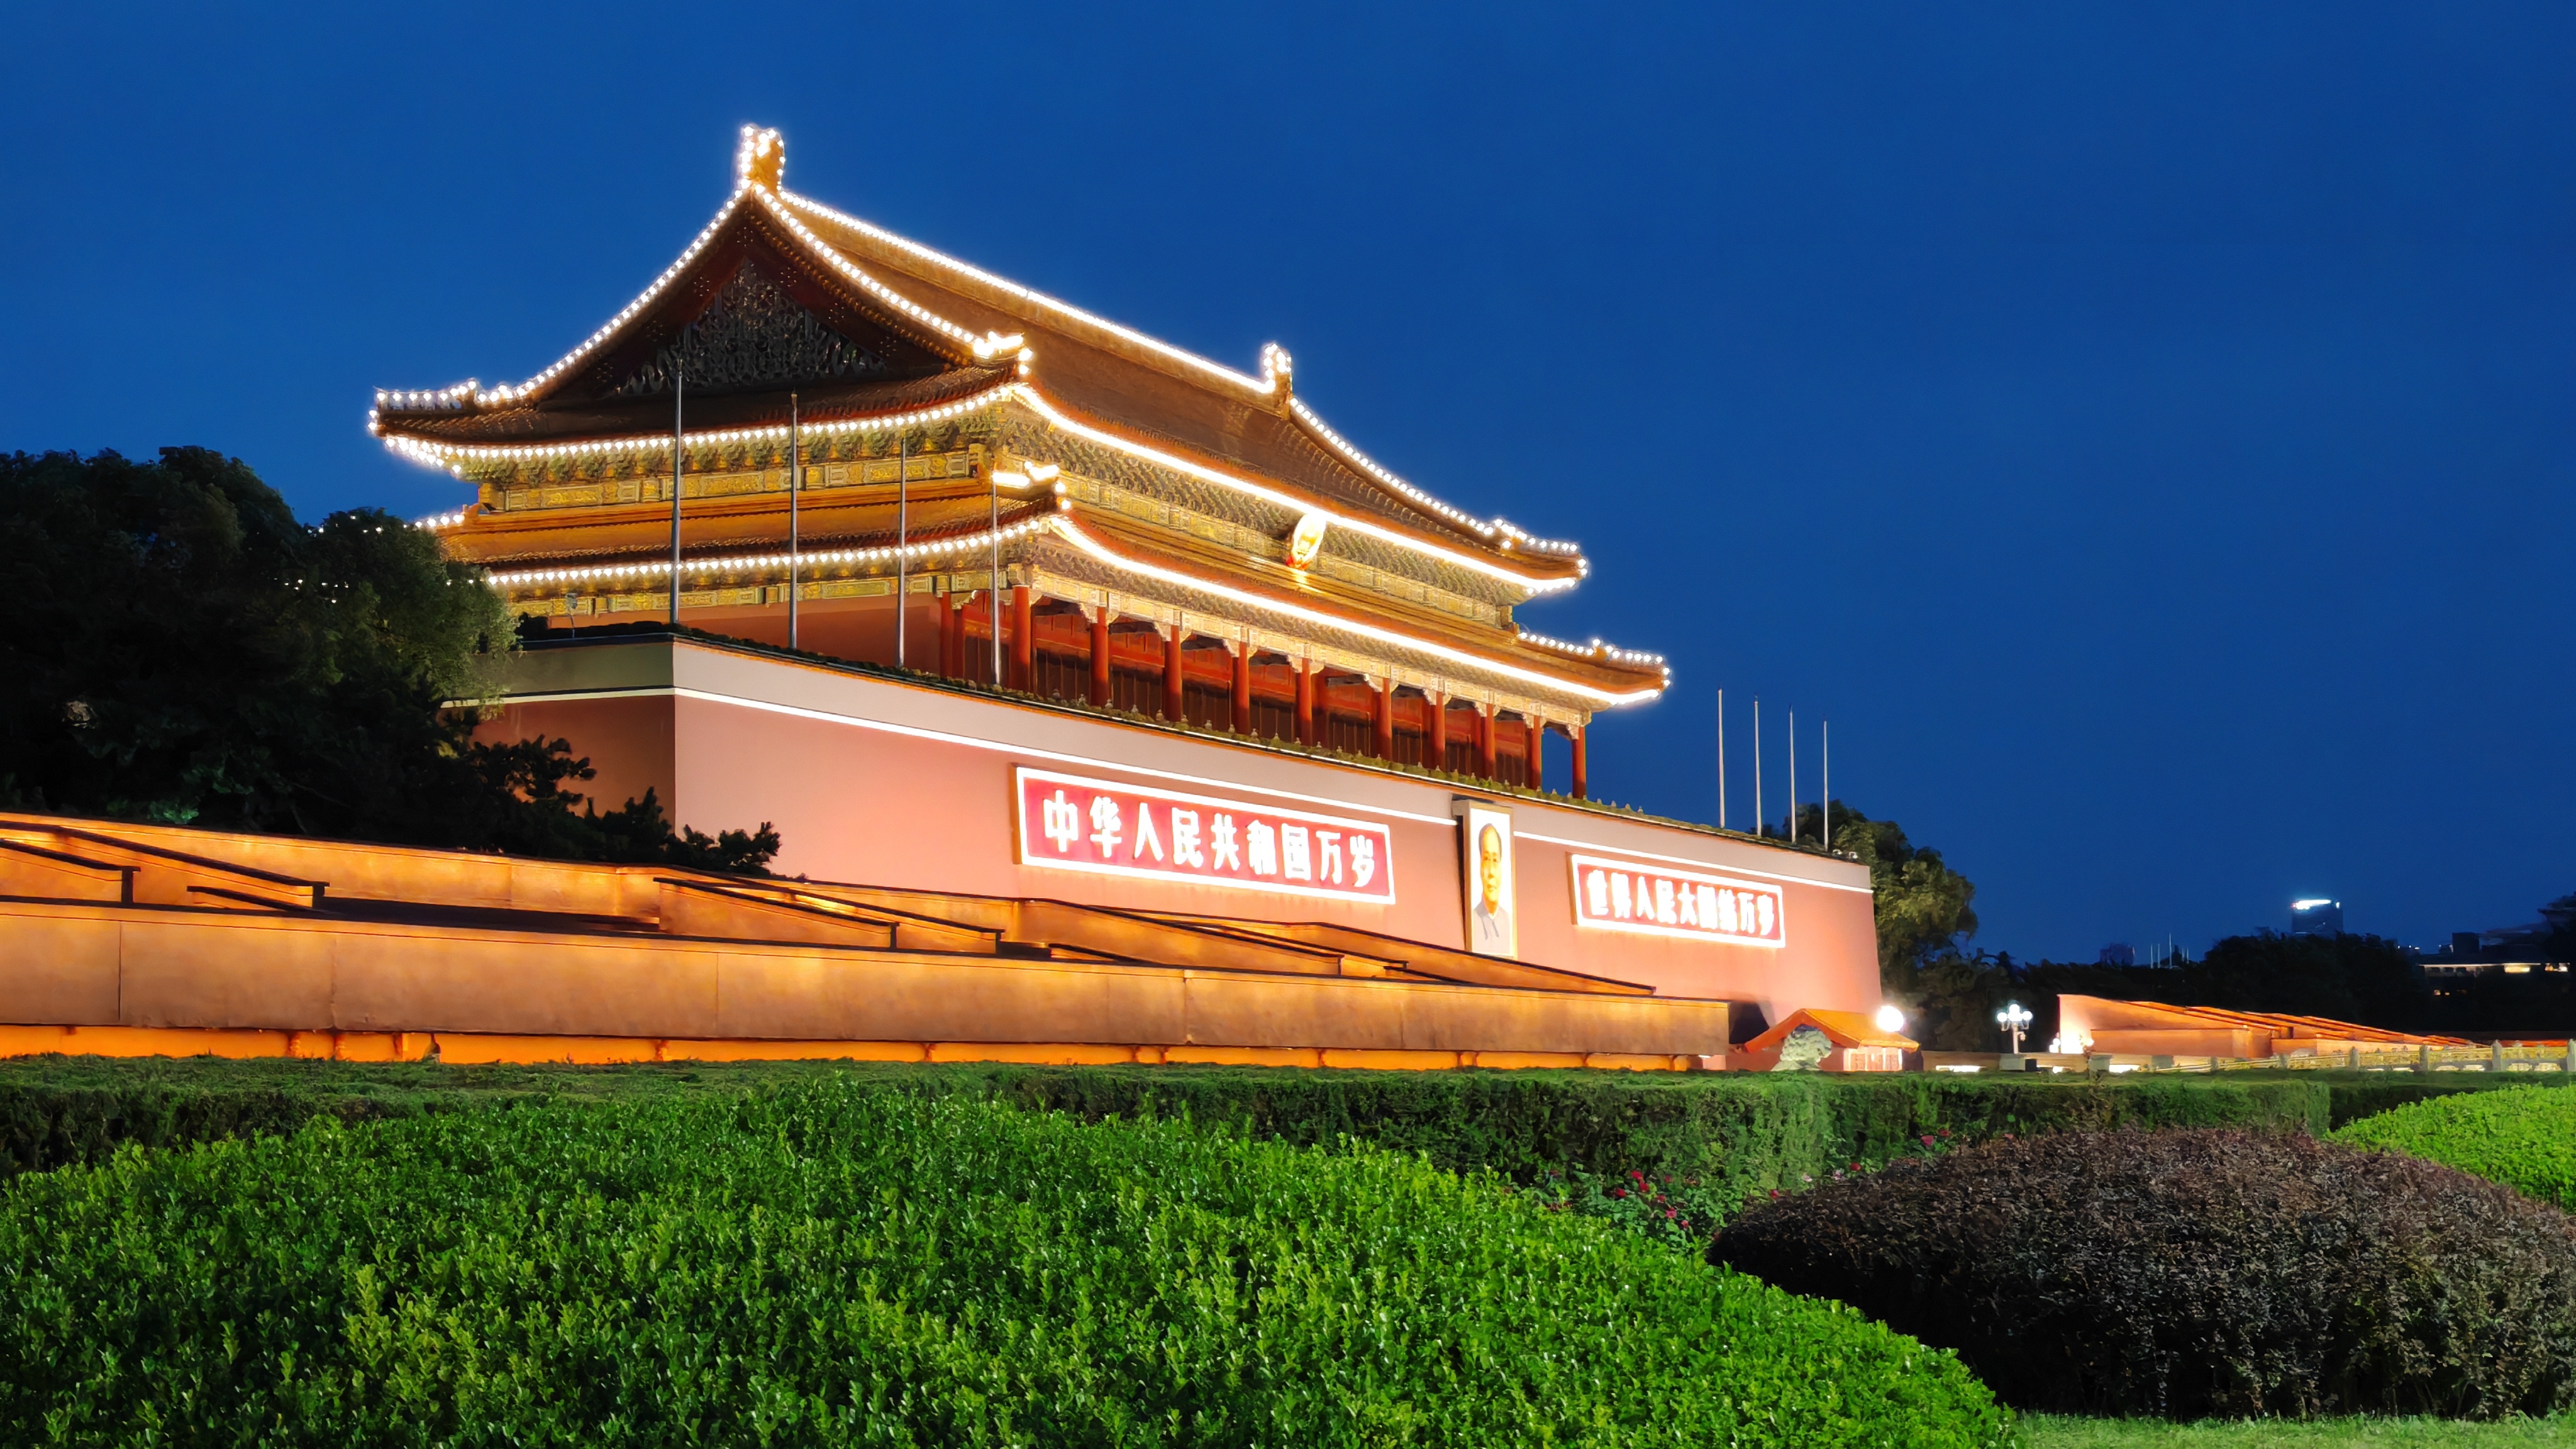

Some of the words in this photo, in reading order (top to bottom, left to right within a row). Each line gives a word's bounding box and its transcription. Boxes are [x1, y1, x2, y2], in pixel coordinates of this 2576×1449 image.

[1043, 790, 1375, 887] 中华人民共和国万岁
